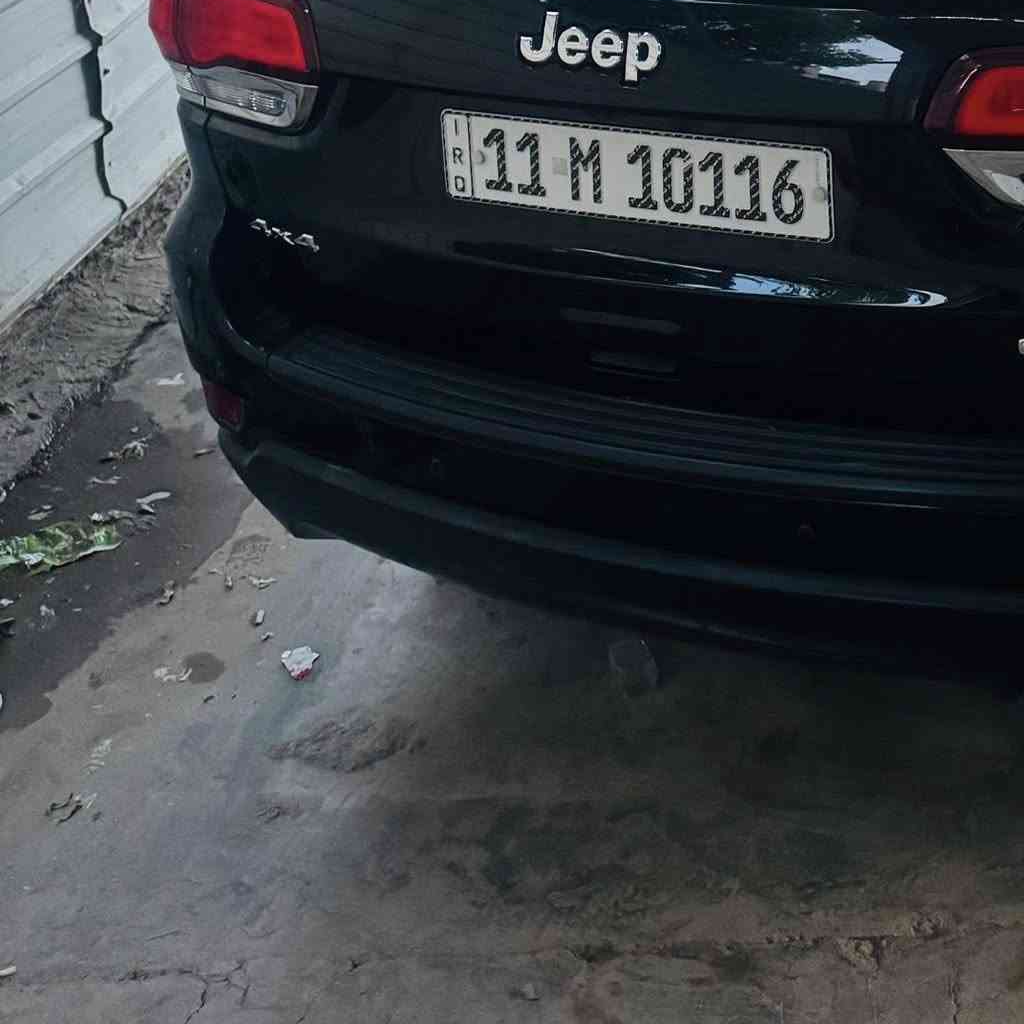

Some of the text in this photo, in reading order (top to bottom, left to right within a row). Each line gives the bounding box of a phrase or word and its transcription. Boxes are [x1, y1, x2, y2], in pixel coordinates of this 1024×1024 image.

[520, 11, 662, 81] Jeep
[483, 128, 804, 225] 11 M 10116
